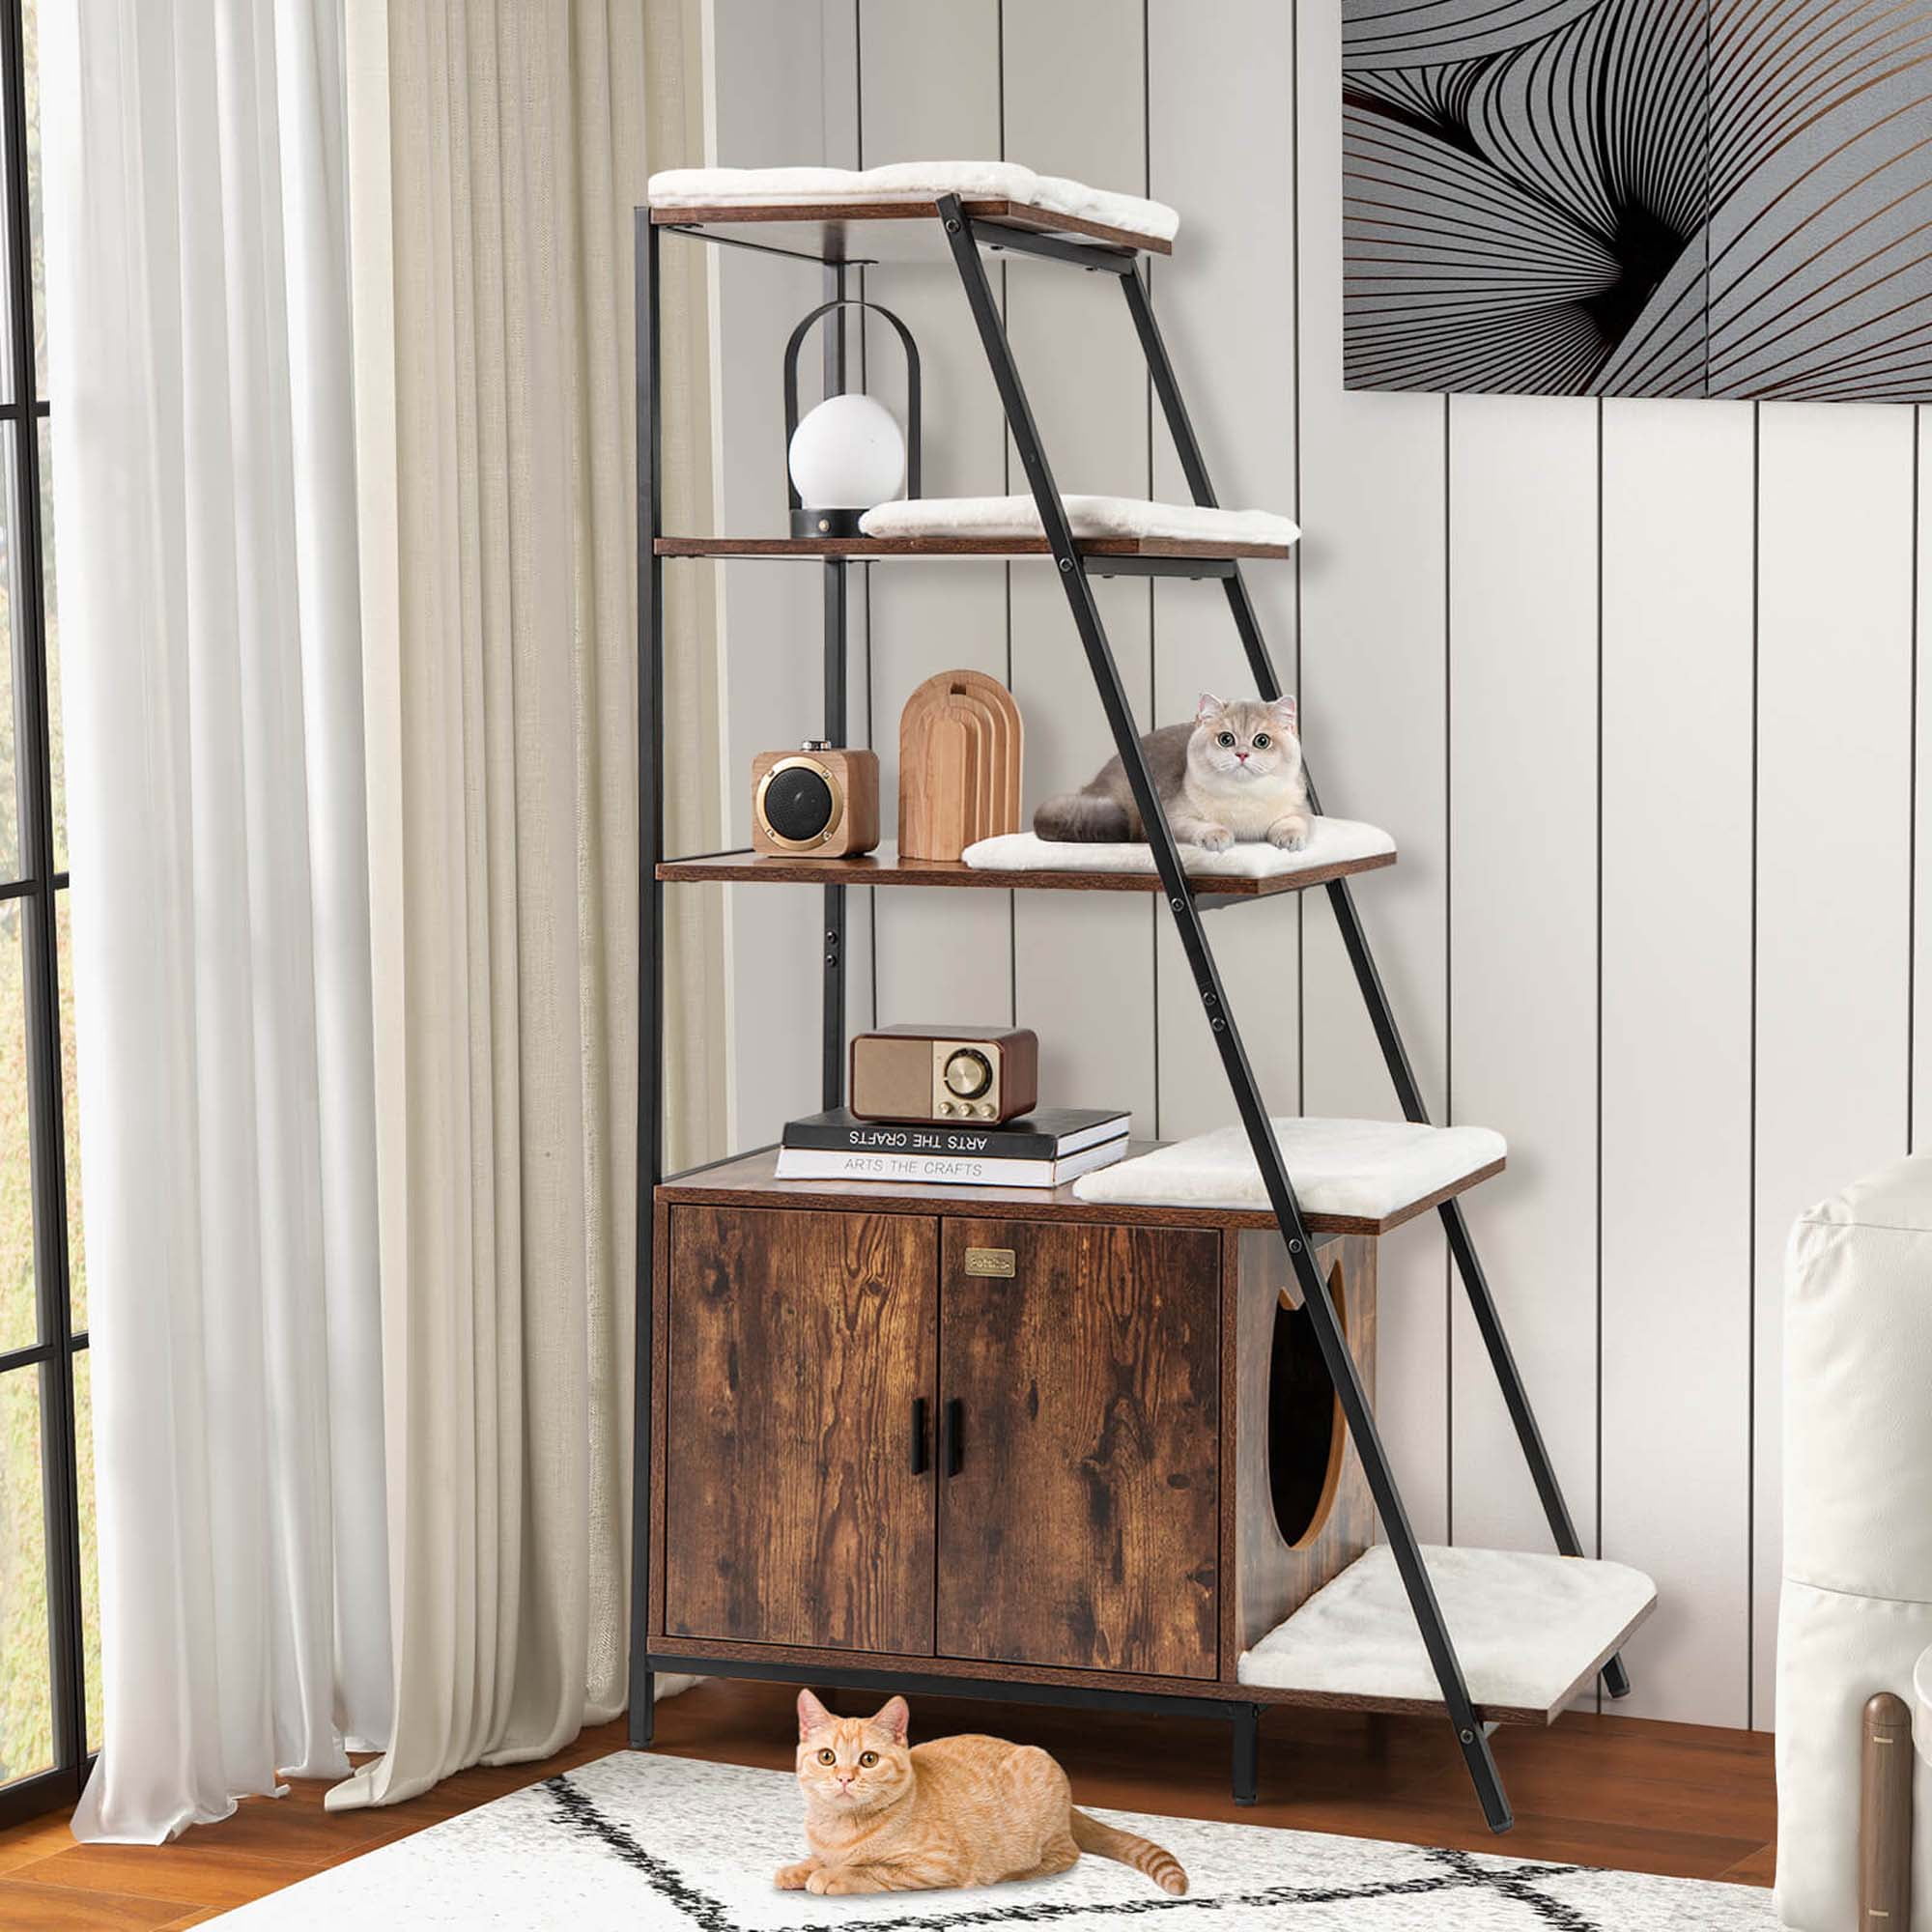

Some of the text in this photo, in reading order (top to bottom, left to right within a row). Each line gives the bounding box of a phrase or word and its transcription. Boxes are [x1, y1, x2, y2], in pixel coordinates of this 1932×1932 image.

[849, 1130, 988, 1151] ARTS THE CRAFTS
[844, 1158, 982, 1177] ARTS THE CRAFTS
